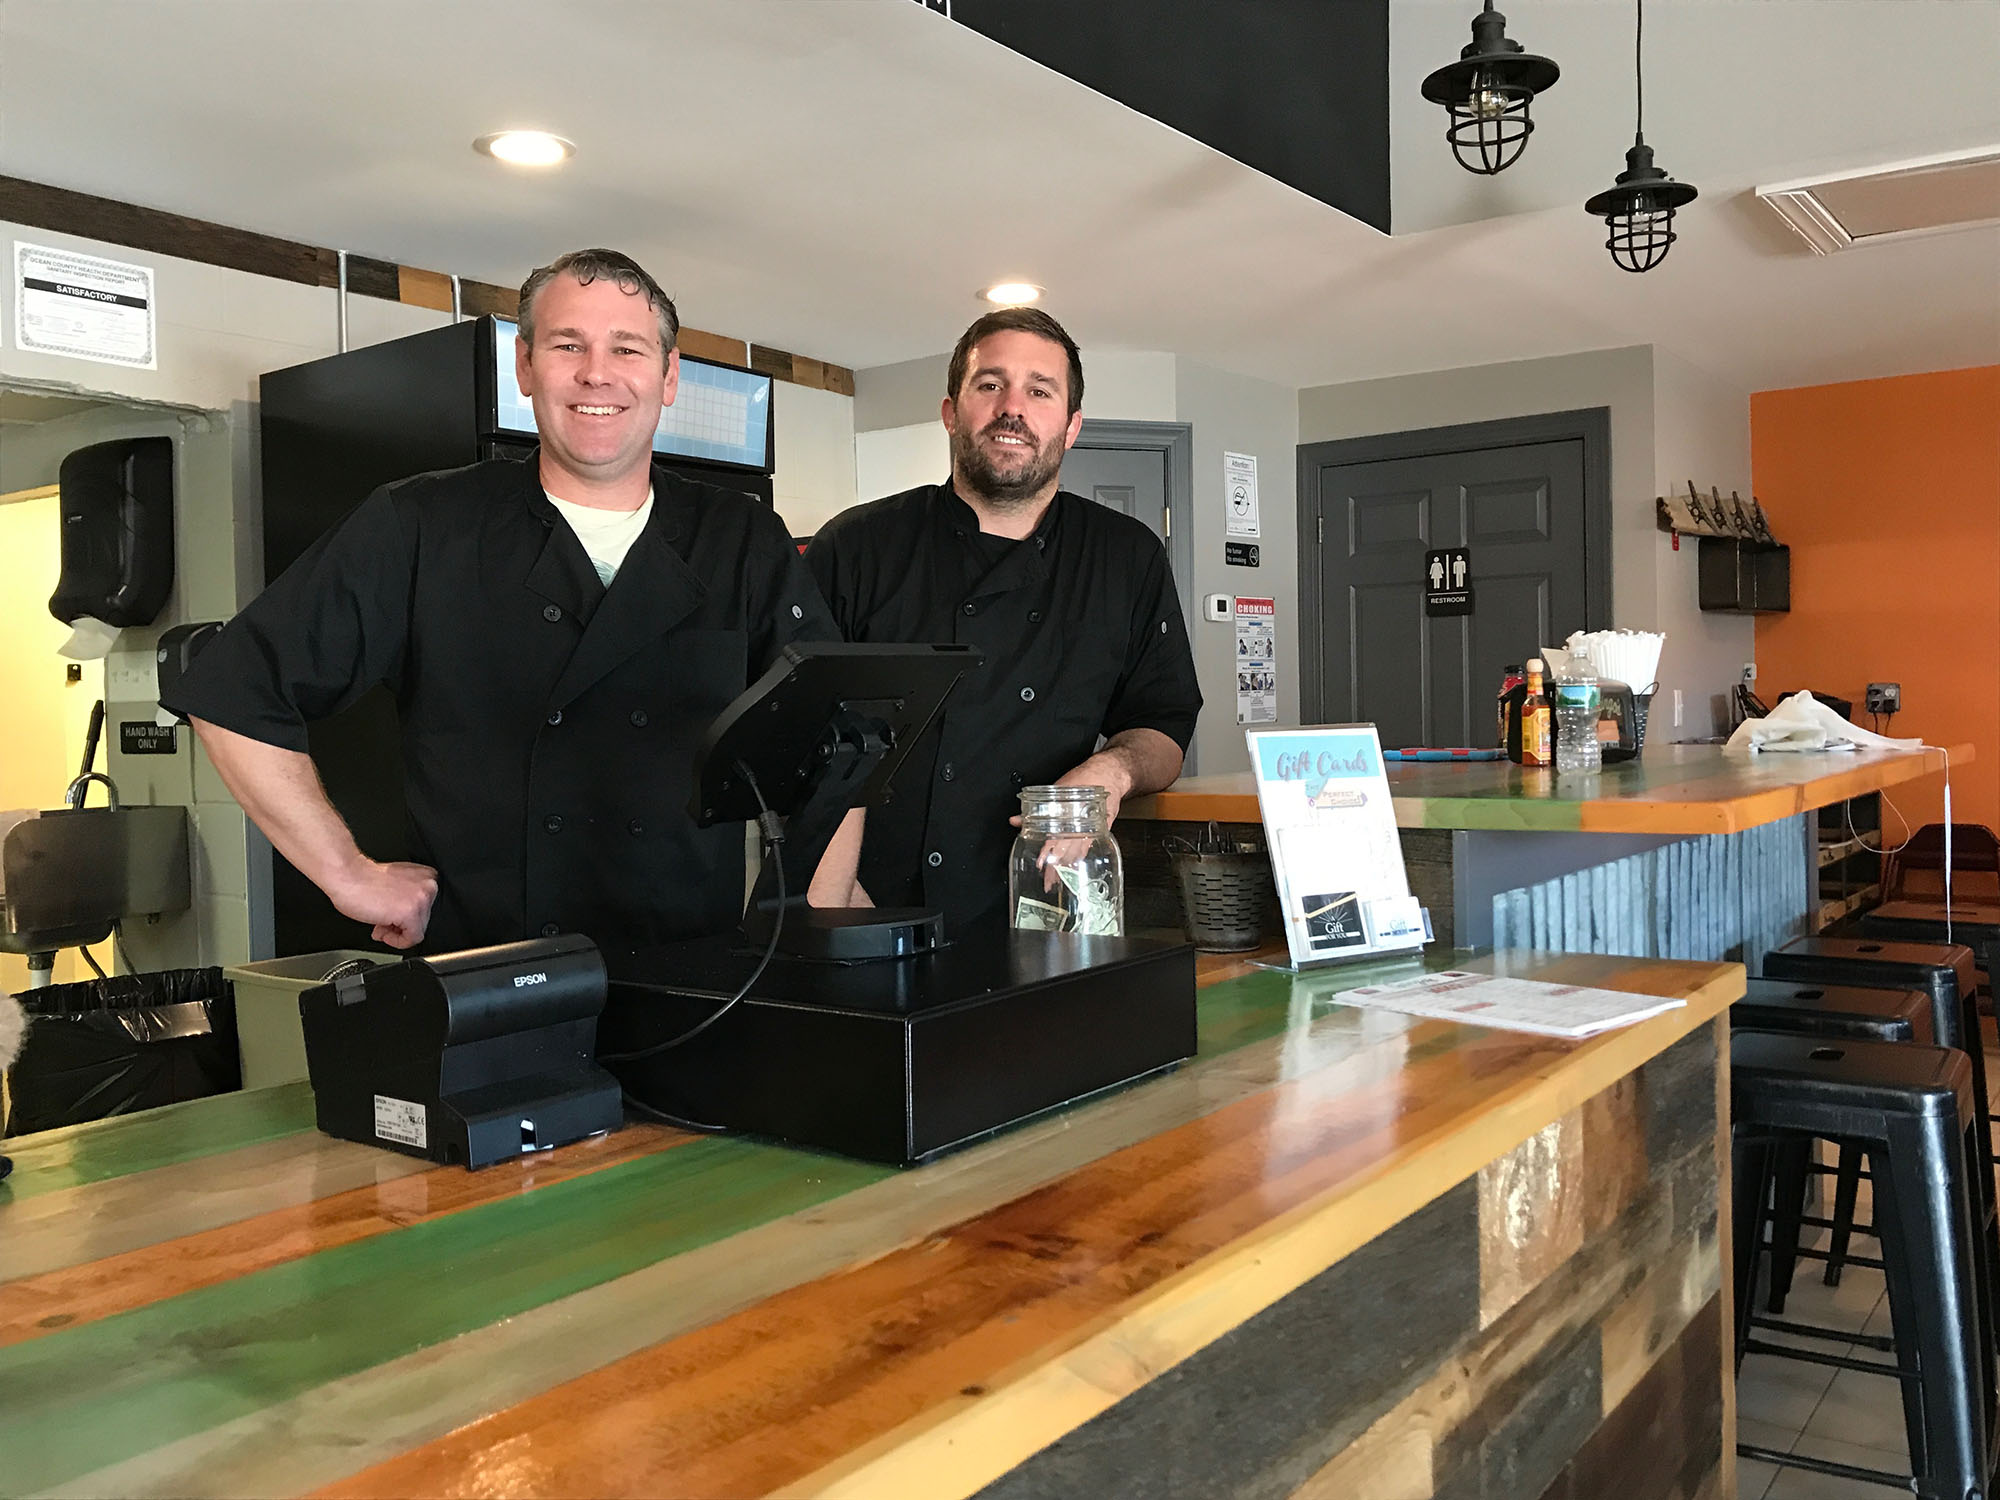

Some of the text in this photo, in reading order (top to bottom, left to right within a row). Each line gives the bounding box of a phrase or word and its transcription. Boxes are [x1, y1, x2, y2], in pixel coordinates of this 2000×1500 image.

[30, 257, 140, 283] OCEAN COUNTY HEALTH DEPARTMENT
[47, 266, 125, 285] SANITARY INSPECTION REPORT
[56, 284, 117, 302] SATISFACTORY
[1430, 596, 1466, 604] RESTROOM
[1237, 603, 1273, 614] CHOKING
[125, 727, 170, 737] HAND WASH
[137, 738, 158, 749] ONLY
[1277, 748, 1369, 781] Gift Cards
[1325, 921, 1344, 934] Gift
[513, 972, 547, 988] EPSON
